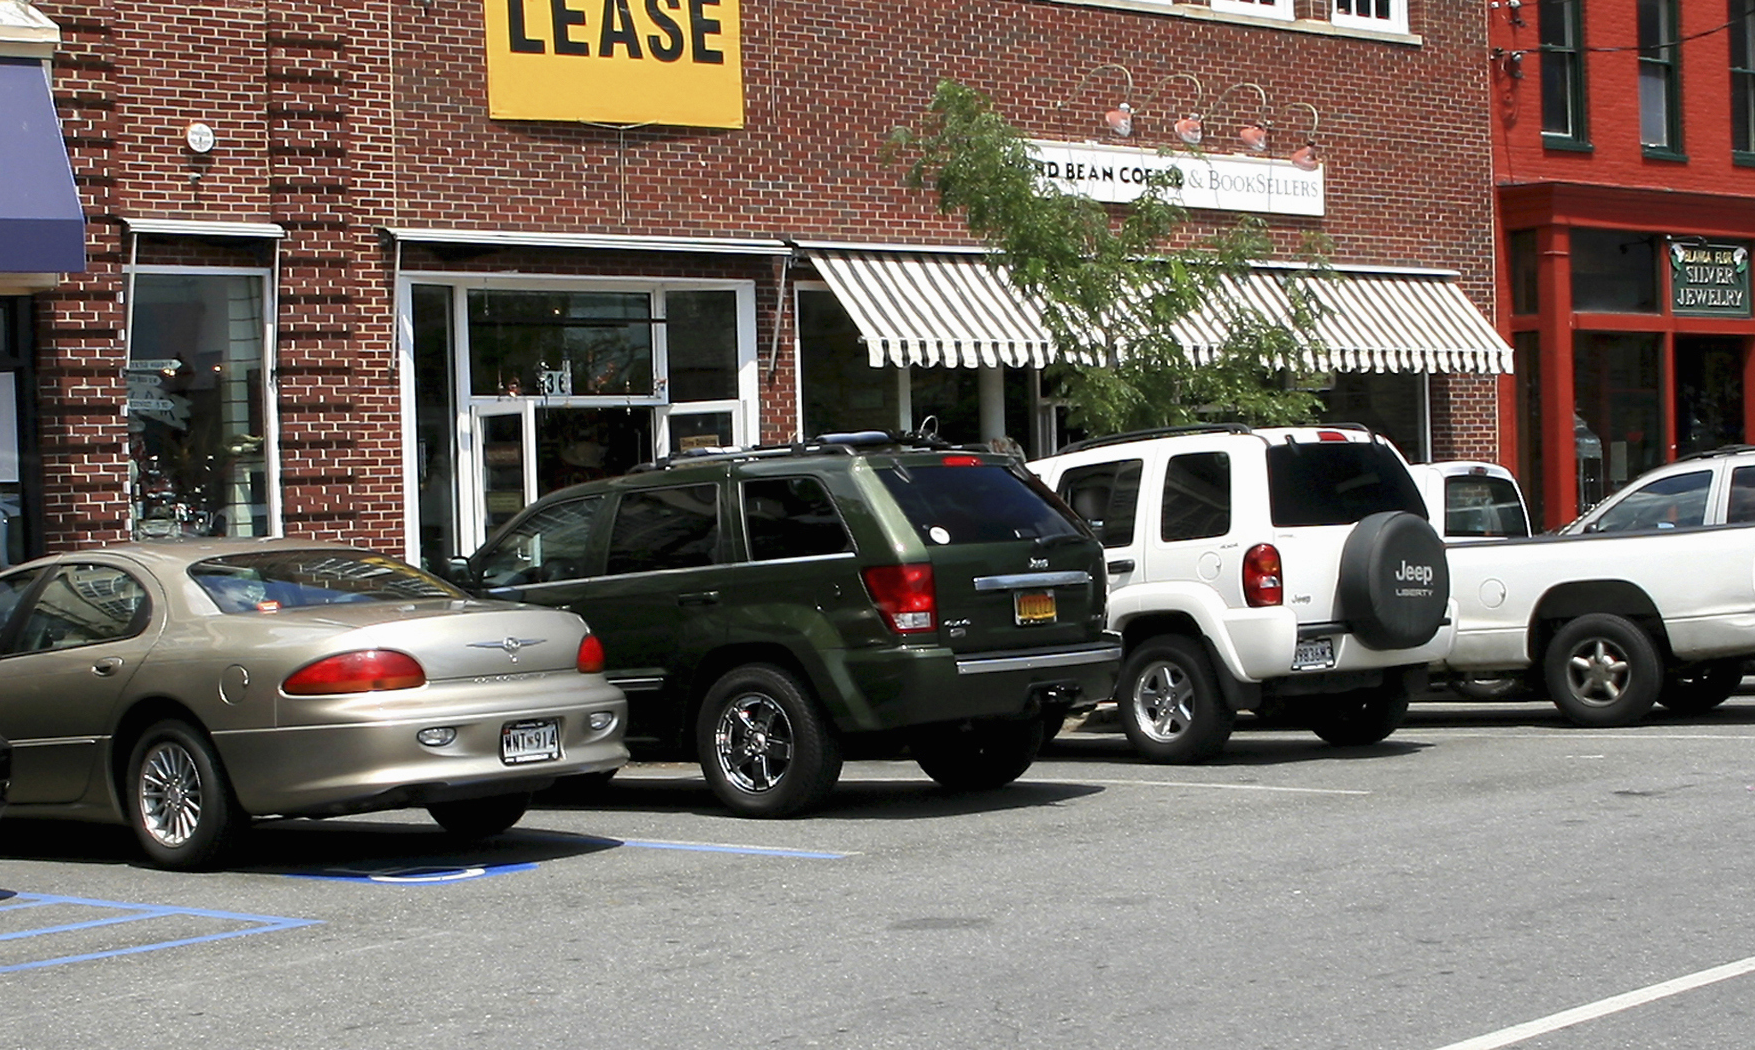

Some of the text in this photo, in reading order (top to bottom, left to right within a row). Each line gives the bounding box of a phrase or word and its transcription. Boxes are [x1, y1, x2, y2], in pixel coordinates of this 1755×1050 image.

[1065, 162, 1114, 182] BEAN
[1119, 166, 1184, 188] COF
[1188, 169, 1204, 189] &
[1208, 169, 1320, 198] BOOKSELLERS
[1685, 265, 1735, 285] SILVER
[1676, 288, 1744, 308] JEWELRY
[1395, 559, 1434, 586] Jeep
[1395, 588, 1434, 597] LIBERTY
